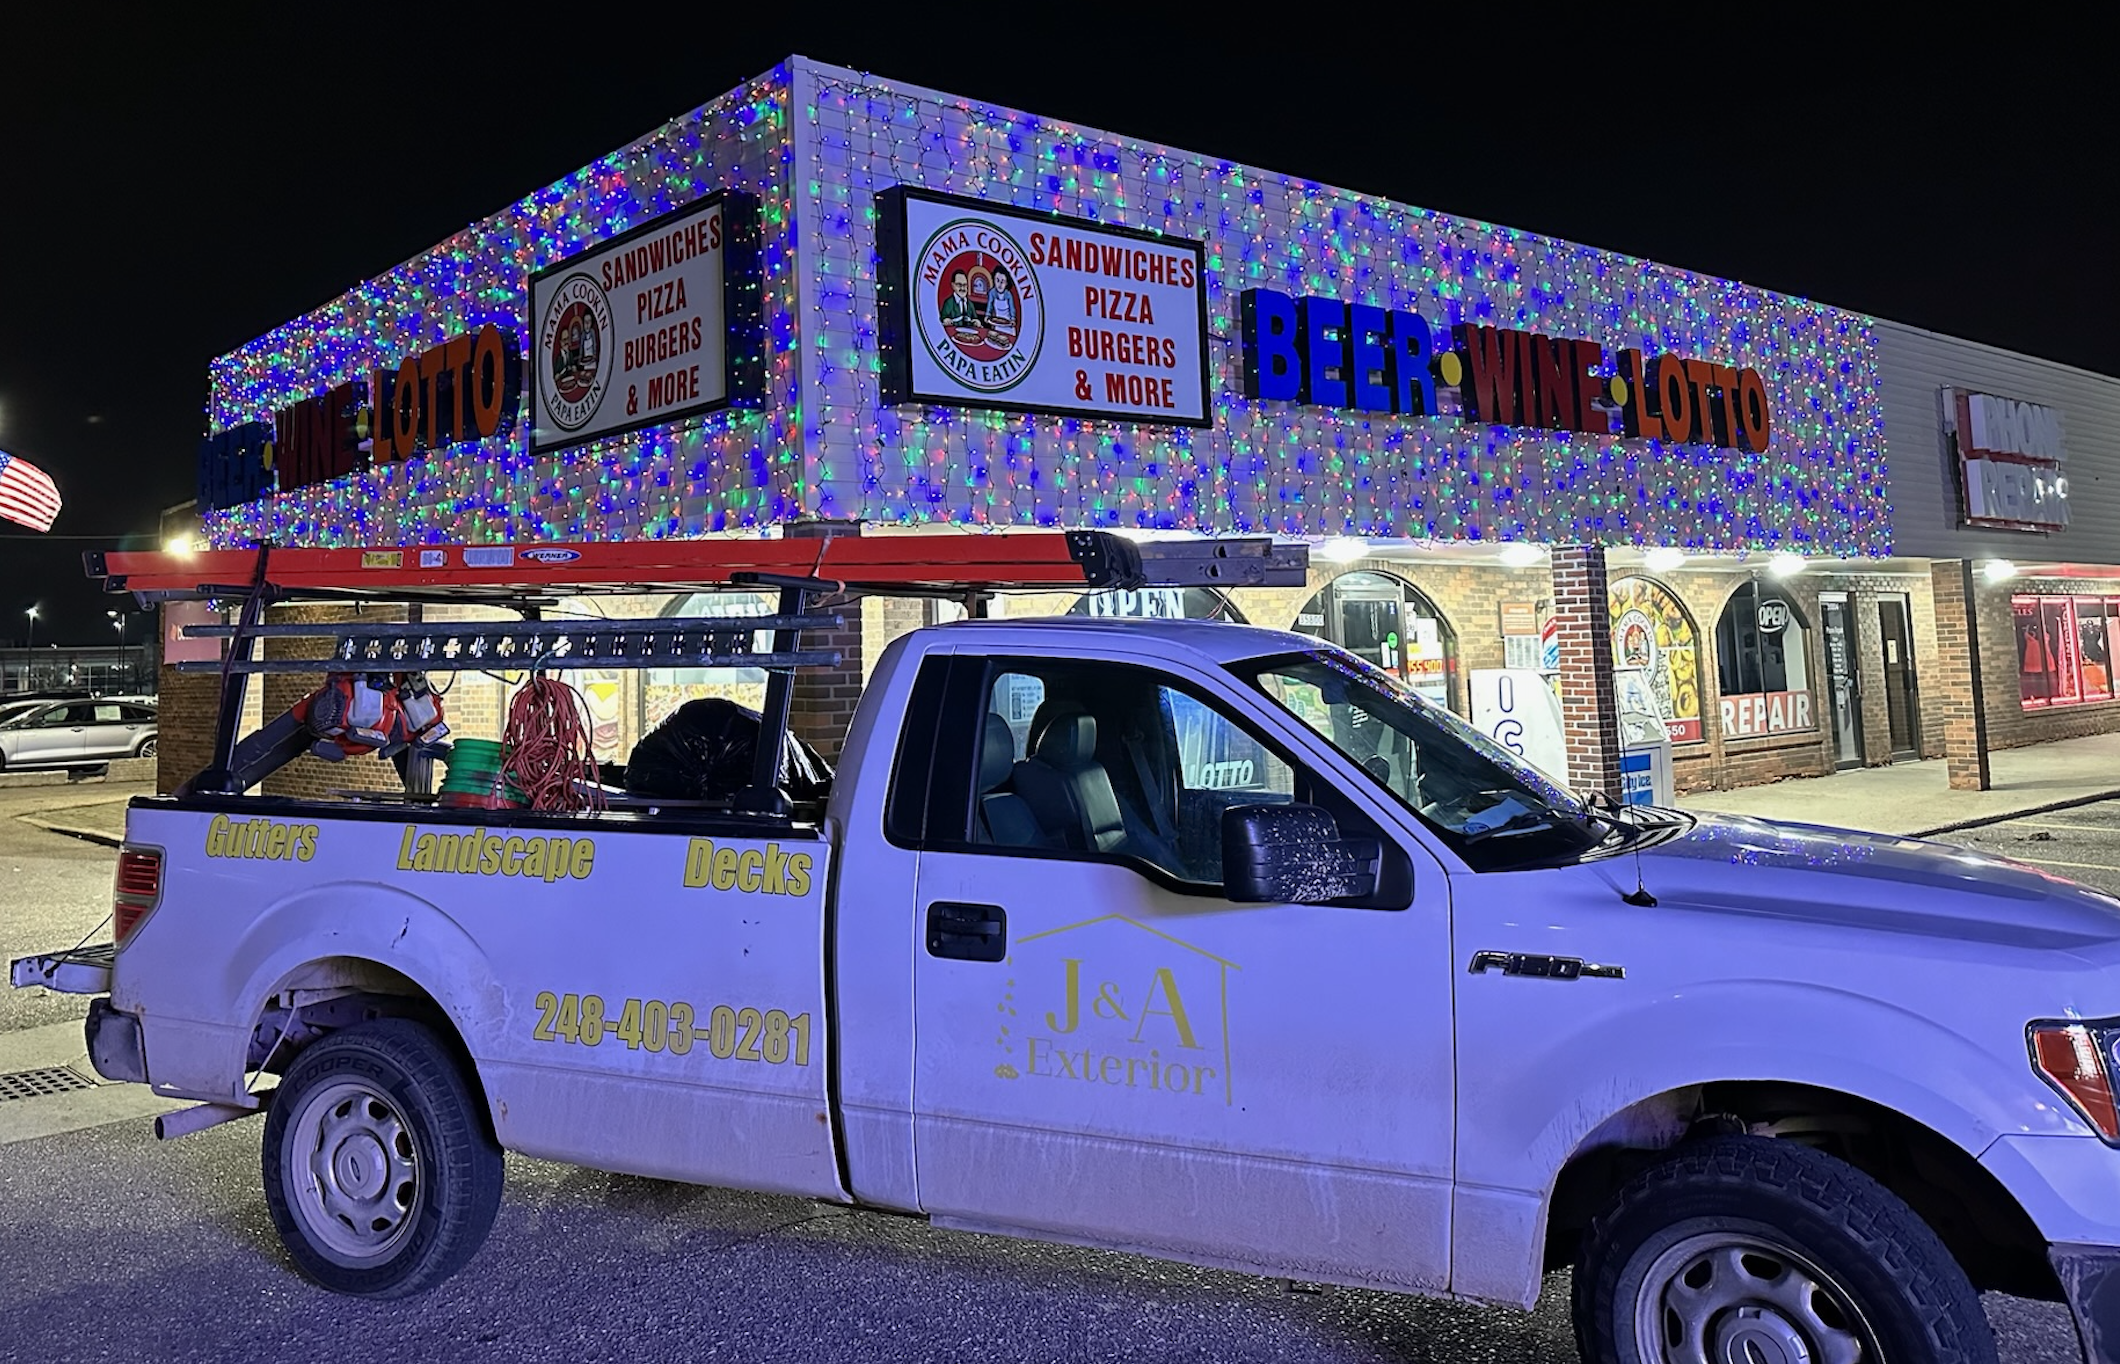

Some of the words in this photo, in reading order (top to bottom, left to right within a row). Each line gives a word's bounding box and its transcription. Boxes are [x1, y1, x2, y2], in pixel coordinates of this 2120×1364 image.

[602, 214, 721, 292] SANDWICHES
[924, 231, 970, 286] MAMA
[977, 231, 1034, 300] COOKIN
[1030, 232, 1195, 289] SANDWICHES
[545, 291, 570, 350] MAMA
[573, 283, 608, 332] COOKIN
[637, 277, 687, 325] PIZZA
[1085, 286, 1154, 325] PIZZA
[624, 316, 702, 372] BURGERS
[937, 338, 977, 381] PAPA
[982, 348, 1026, 382] EATIN
[1068, 326, 1176, 369] BURGERS
[626, 384, 638, 416] &
[648, 365, 700, 411] MORE
[1075, 369, 1093, 401] &
[1105, 372, 1175, 409] MORE
[1250, 289, 1438, 416] BEER
[1458, 322, 1609, 434] WINE
[1625, 348, 1770, 453] LOTTO
[274, 382, 358, 493] WINE
[372, 322, 506, 465] LOTTO
[550, 392, 572, 422] PAPA
[574, 381, 601, 422] EATIN
[1088, 588, 1186, 619] OPEN
[1758, 606, 1788, 626] OPEN
[1720, 693, 1811, 736] REPAIR
[205, 813, 320, 862] Gutters
[396, 825, 596, 883] Landscape
[683, 837, 814, 898] Decks
[533, 991, 811, 1067] 248-403-0281
[294, 1055, 385, 1096] COOPER
[1026, 1036, 1216, 1096] Exterior
